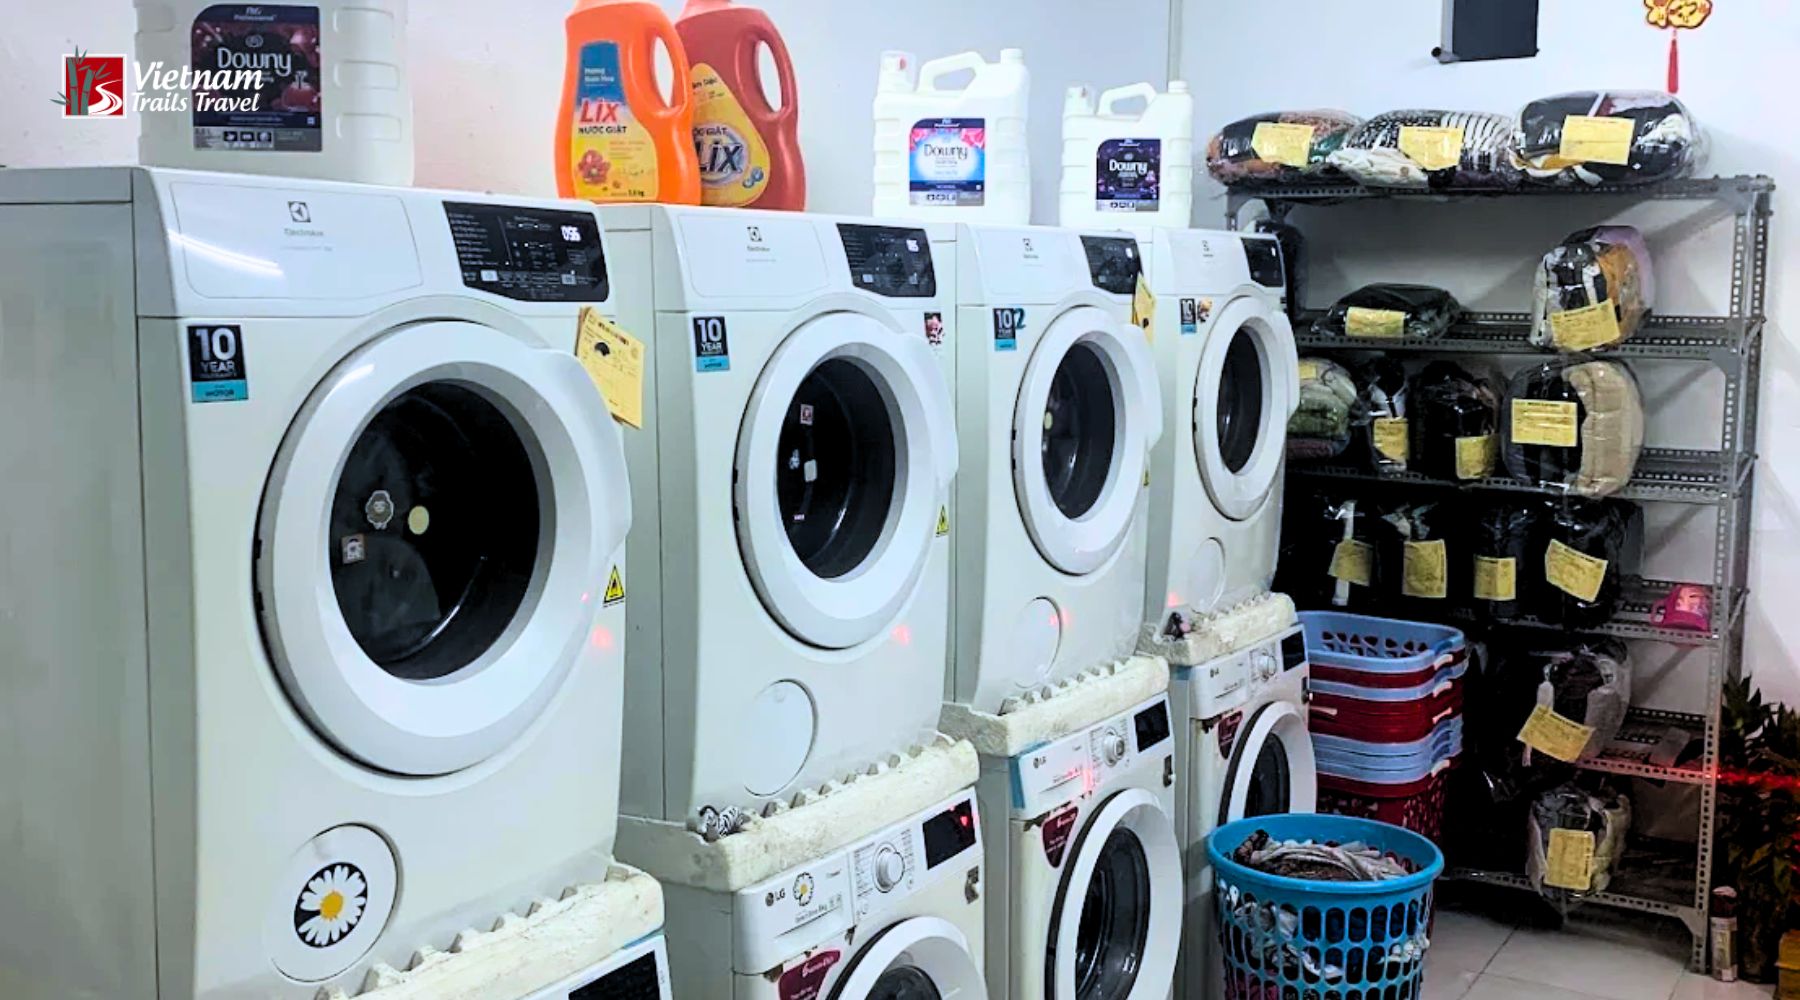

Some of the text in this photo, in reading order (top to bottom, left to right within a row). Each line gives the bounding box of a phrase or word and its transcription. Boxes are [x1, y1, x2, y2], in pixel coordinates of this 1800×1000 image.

[217, 46, 292, 77] Downy
[923, 143, 968, 160] Downy
[1109, 159, 1148, 176] Downy
[996, 310, 1012, 329] 10
[1014, 308, 1026, 329] 2
[697, 318, 722, 342] 10
[196, 327, 236, 360] 10
[201, 361, 235, 373] YEAR
